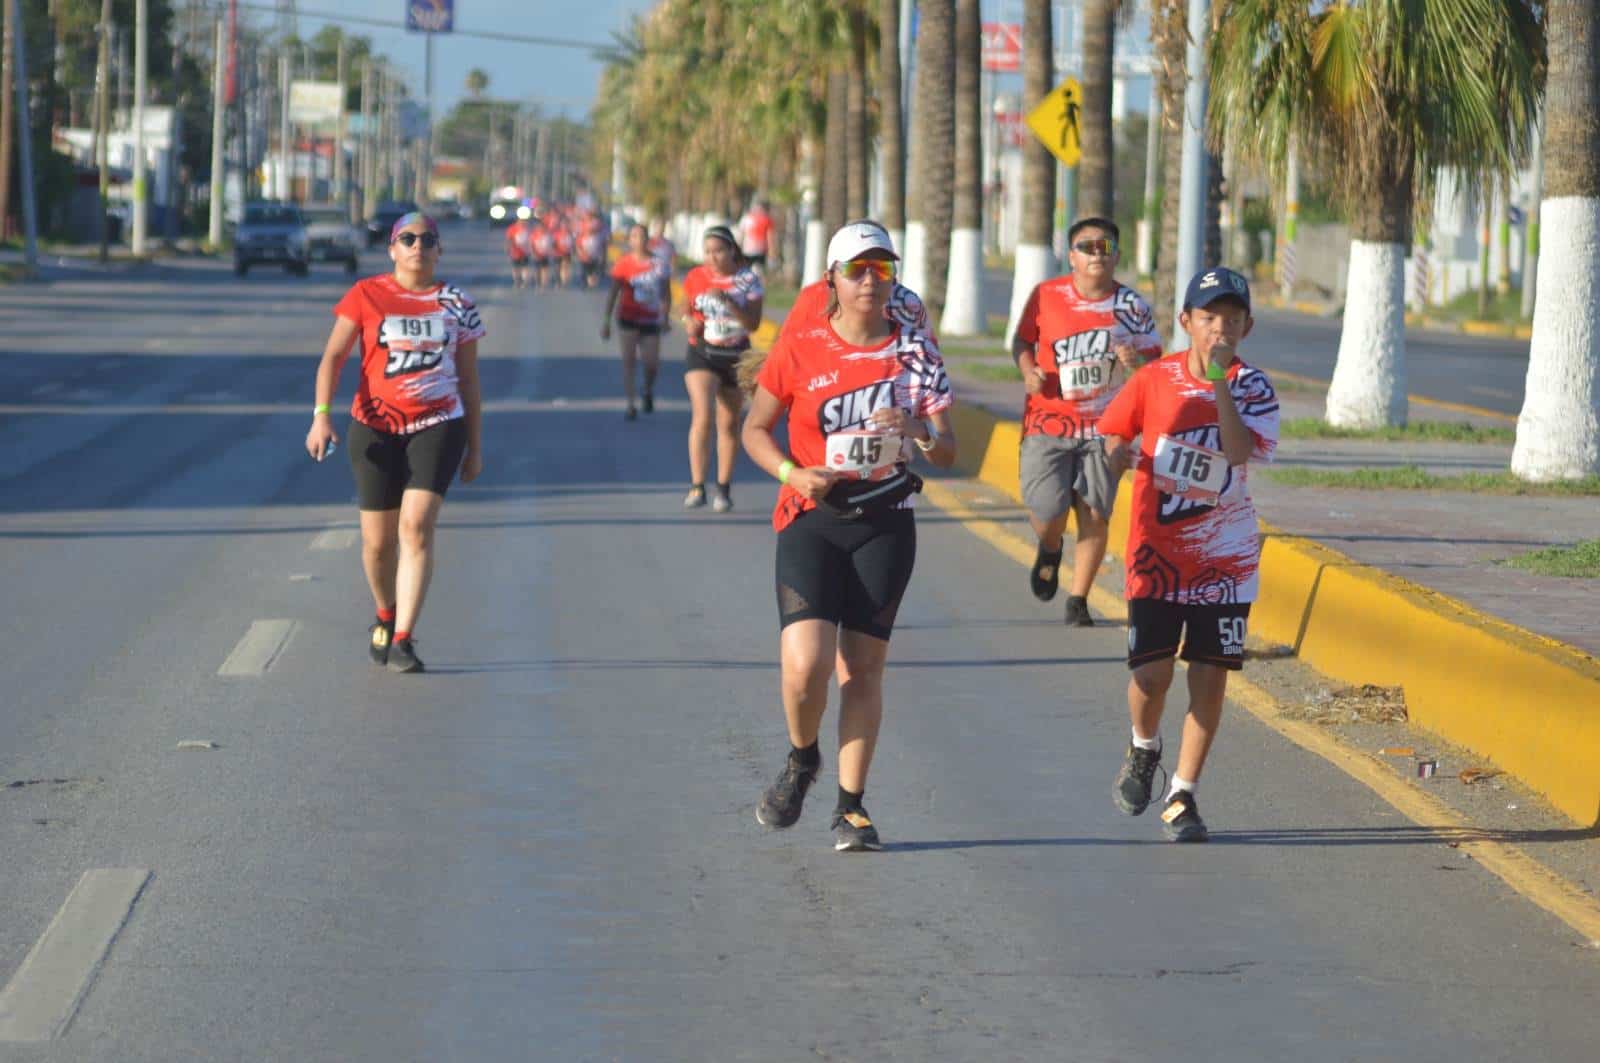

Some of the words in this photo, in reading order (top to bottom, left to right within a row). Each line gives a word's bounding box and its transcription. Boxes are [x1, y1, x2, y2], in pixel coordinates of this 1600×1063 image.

[400, 318, 432, 337] 191
[1054, 330, 1109, 363] SIKA
[807, 370, 840, 392] JULY
[1069, 366, 1102, 385] 109
[823, 381, 894, 433] SIKA
[847, 437, 882, 465] 45
[1169, 447, 1211, 482] 115
[1218, 617, 1245, 646] 50
